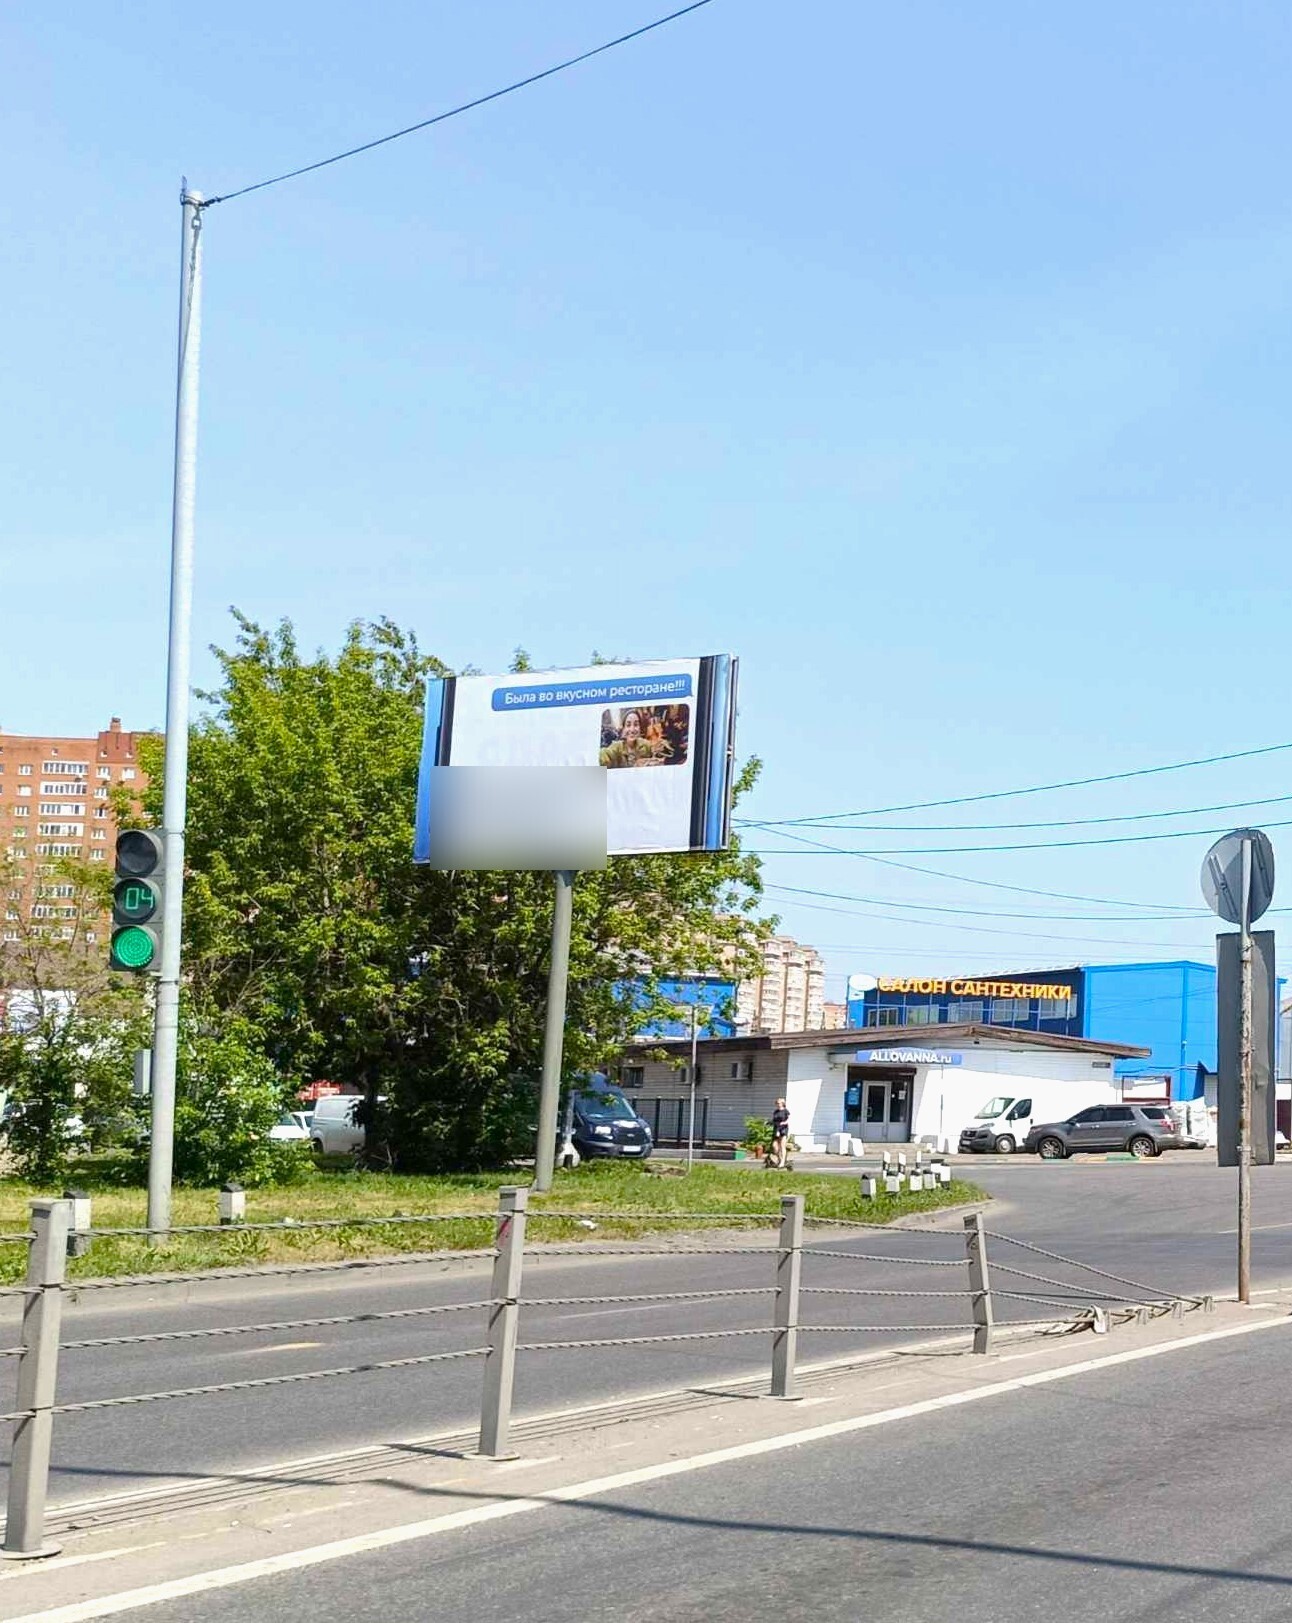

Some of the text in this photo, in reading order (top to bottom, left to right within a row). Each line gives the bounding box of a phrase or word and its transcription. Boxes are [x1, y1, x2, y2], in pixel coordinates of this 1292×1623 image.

[505, 680, 685, 704] Была во вкусном ресторане!!!
[125, 887, 153, 910] 04
[879, 976, 1072, 1000] САЛОН САНТЕХНИКИ
[869, 1050, 953, 1063] ALLOVANNA.ru
